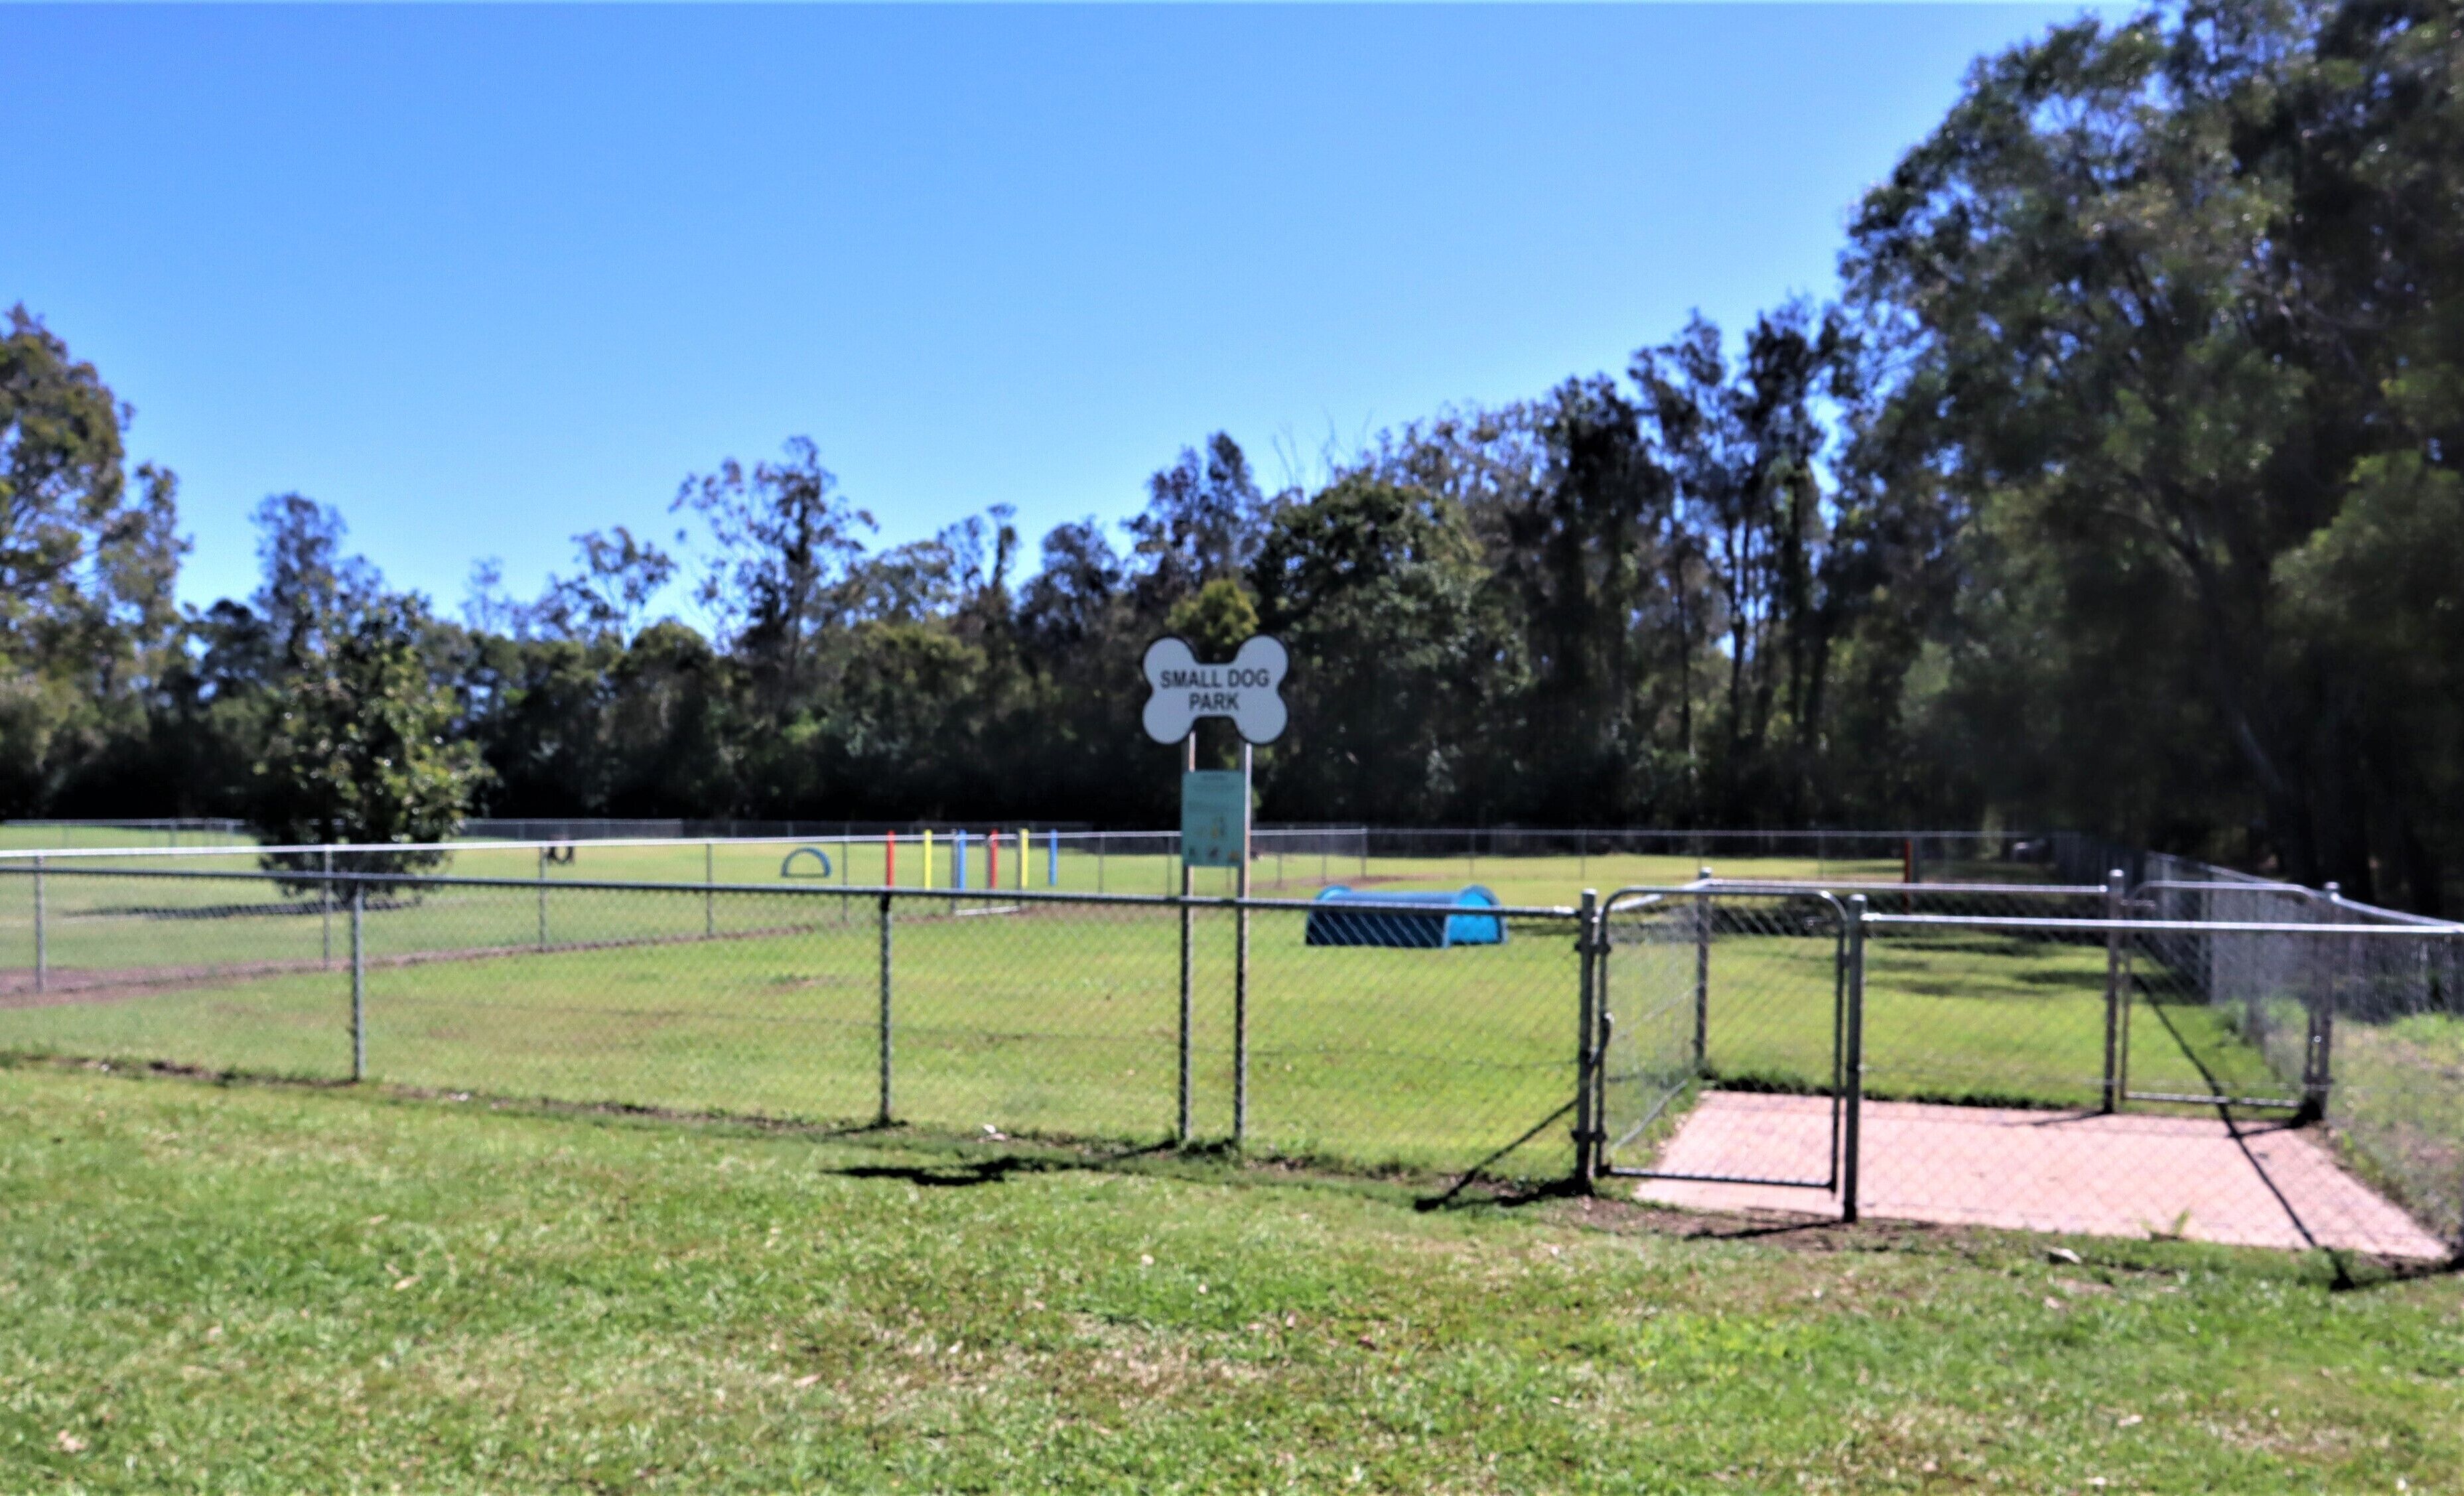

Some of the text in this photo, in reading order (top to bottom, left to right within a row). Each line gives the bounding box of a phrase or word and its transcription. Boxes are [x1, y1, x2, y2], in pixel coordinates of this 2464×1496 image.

[1160, 668, 1270, 689] SMALL DOG
[1189, 693, 1239, 711] PARK
